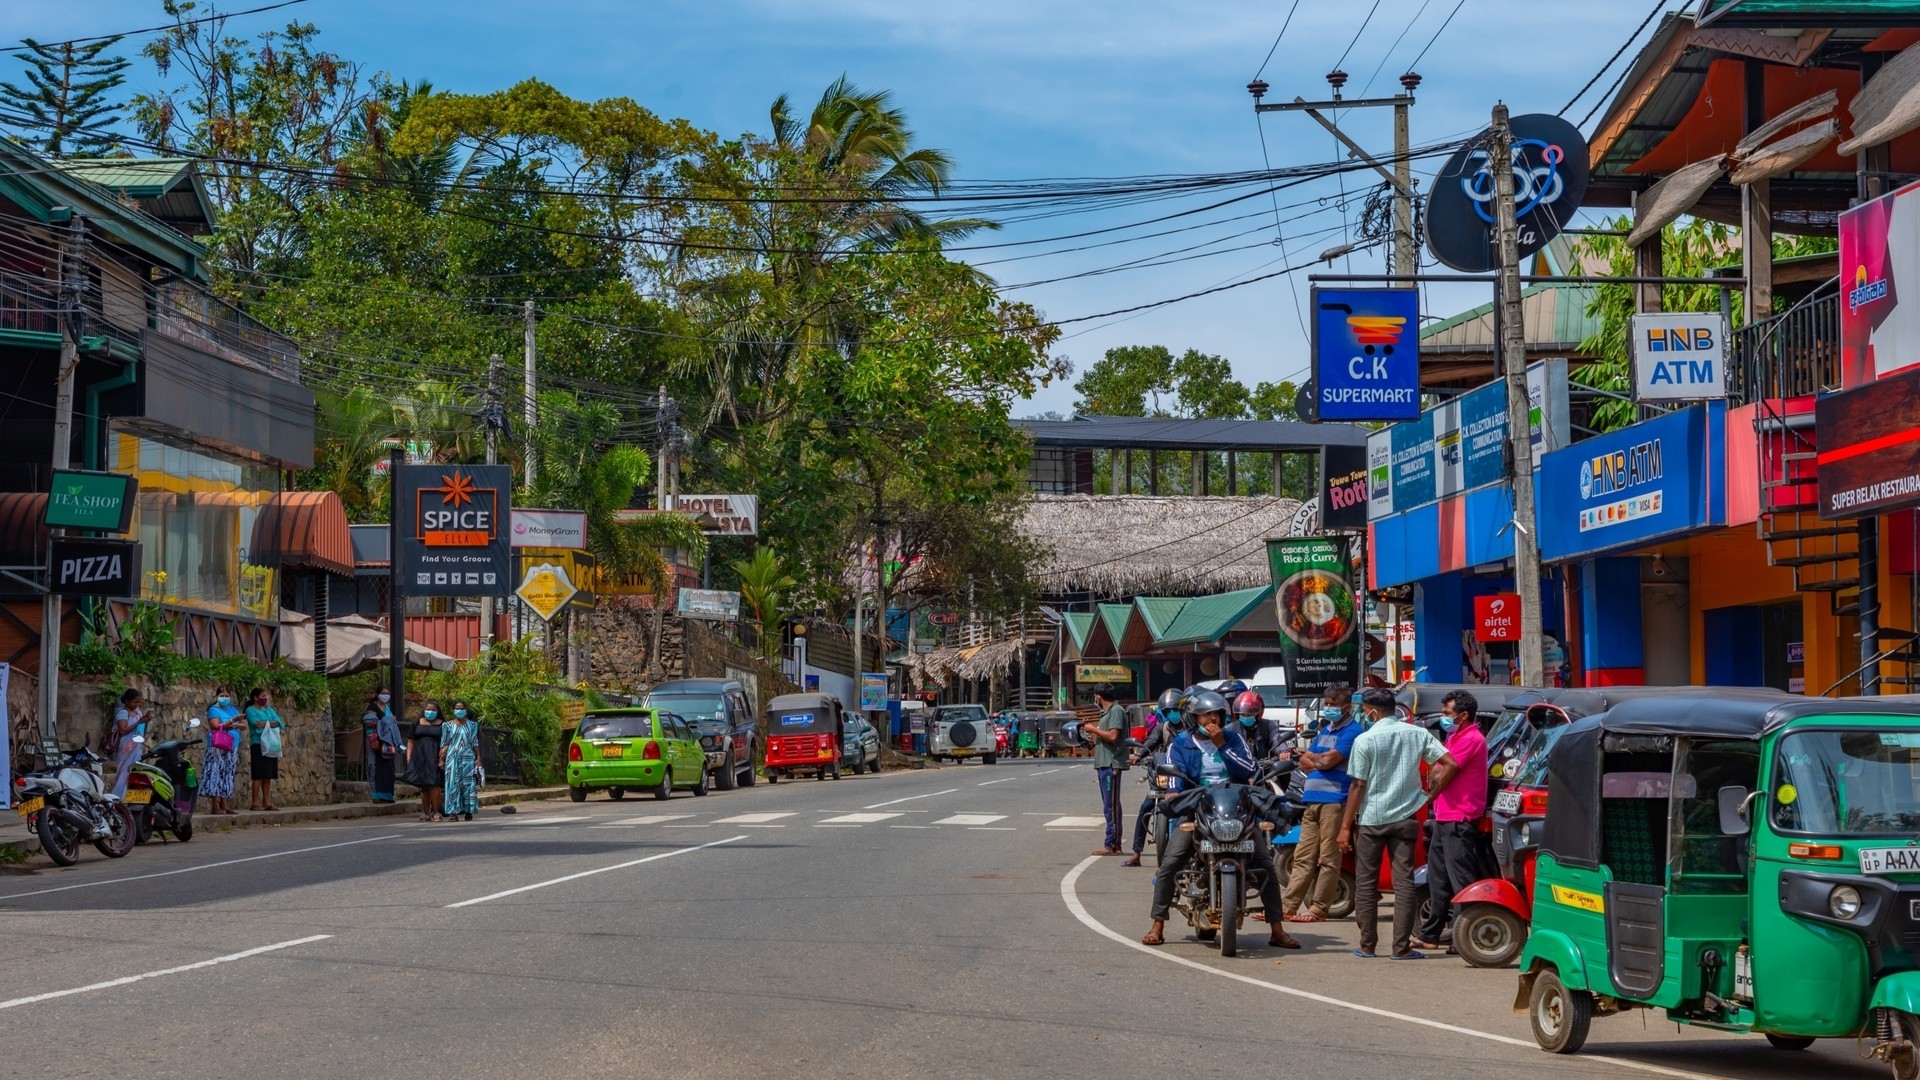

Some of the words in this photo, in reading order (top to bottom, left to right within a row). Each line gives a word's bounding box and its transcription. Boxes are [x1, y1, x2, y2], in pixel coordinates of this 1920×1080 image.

[1647, 328, 1714, 352] HNB
[1348, 356, 1388, 380] C.K
[1650, 360, 1713, 385] ATM
[1322, 388, 1414, 403] SUPERMART
[1591, 449, 1628, 498] HNB
[1628, 438, 1662, 487] ATM
[54, 493, 80, 506] TEA
[82, 495, 119, 508] SHOP
[1330, 478, 1367, 510] Rott
[1832, 489, 1855, 511] SUPER
[1856, 483, 1880, 505] RELAX
[678, 498, 733, 513] HOTEL
[424, 511, 489, 529] SPICE
[445, 534, 470, 544] ELLA
[528, 526, 579, 536] MoneyGram
[1283, 554, 1303, 563] Rice
[1303, 554, 1311, 562] &
[1311, 553, 1338, 563] Curry
[60, 554, 122, 585] PIZZA
[1484, 616, 1512, 627] airtel
[1490, 627, 1507, 637] 4G
[1322, 656, 1347, 664] Included
[1864, 860, 1880, 871] UP
[1885, 850, 1920, 870] AAX
